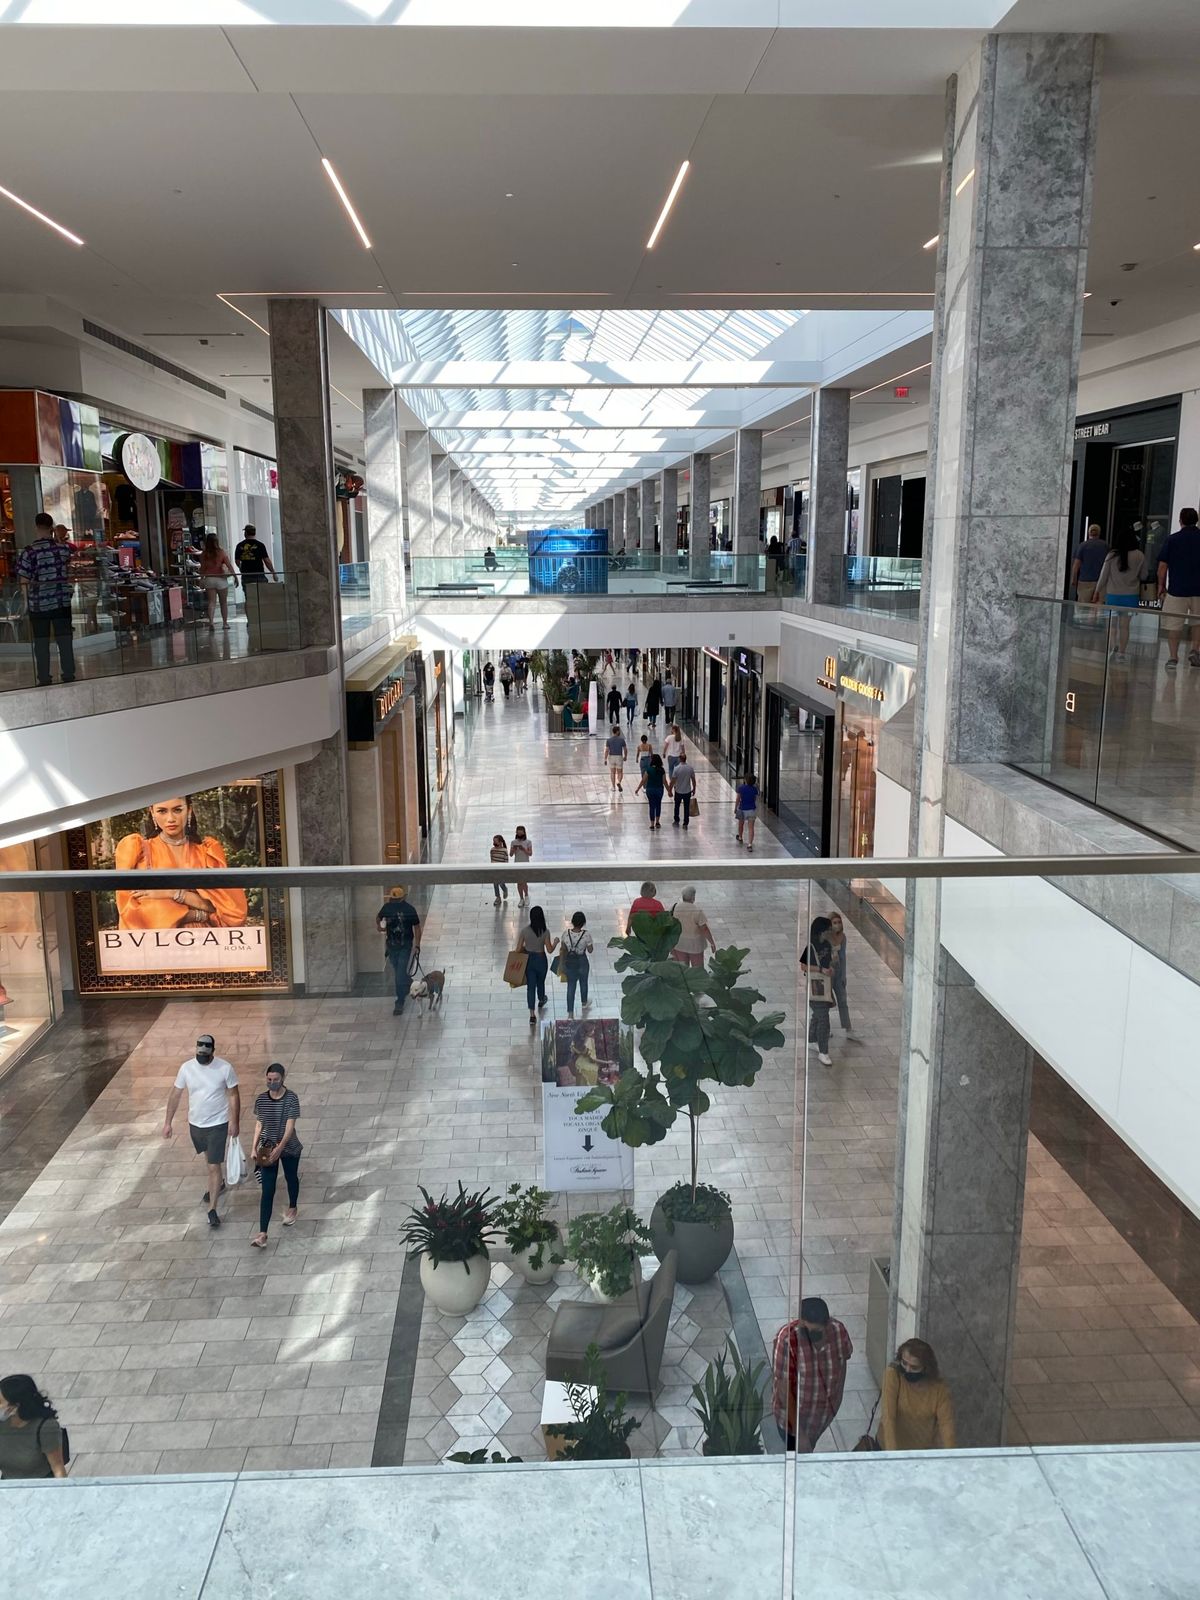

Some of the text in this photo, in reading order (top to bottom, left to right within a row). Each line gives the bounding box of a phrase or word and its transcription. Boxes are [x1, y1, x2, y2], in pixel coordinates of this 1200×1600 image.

[1074, 423, 1109, 439] STREET WEAR
[376, 677, 403, 719] BVLGARI
[104, 930, 262, 948] BVLGARI
